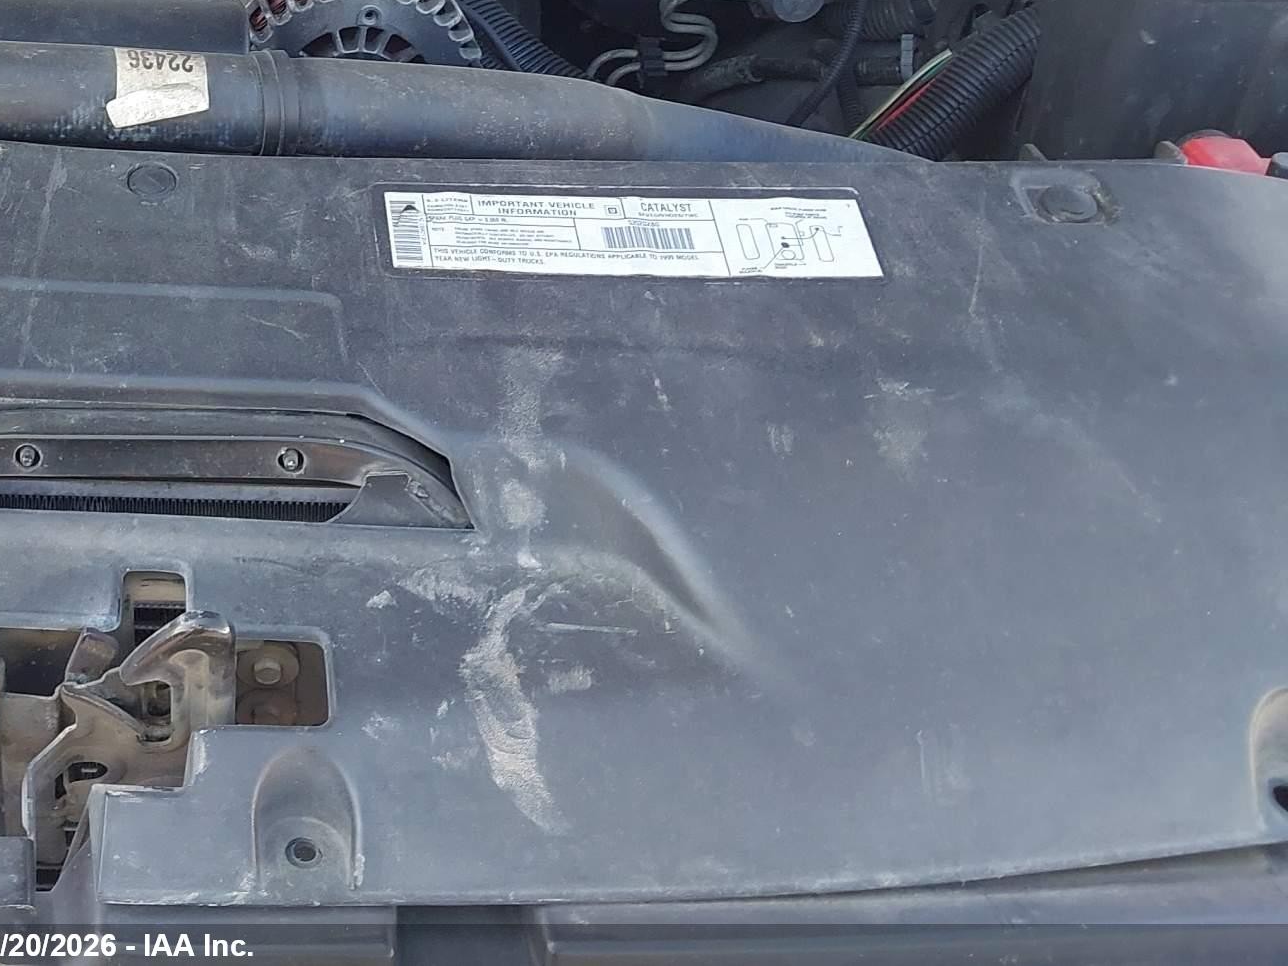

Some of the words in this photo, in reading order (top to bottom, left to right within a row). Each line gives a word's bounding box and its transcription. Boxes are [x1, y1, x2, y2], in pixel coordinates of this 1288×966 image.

[127, 50, 194, 73] 22436
[477, 200, 544, 209] IMPORTANT
[548, 201, 596, 210] VEHICLE
[640, 202, 692, 213] CATALYST
[497, 208, 577, 216] INFORMATION
